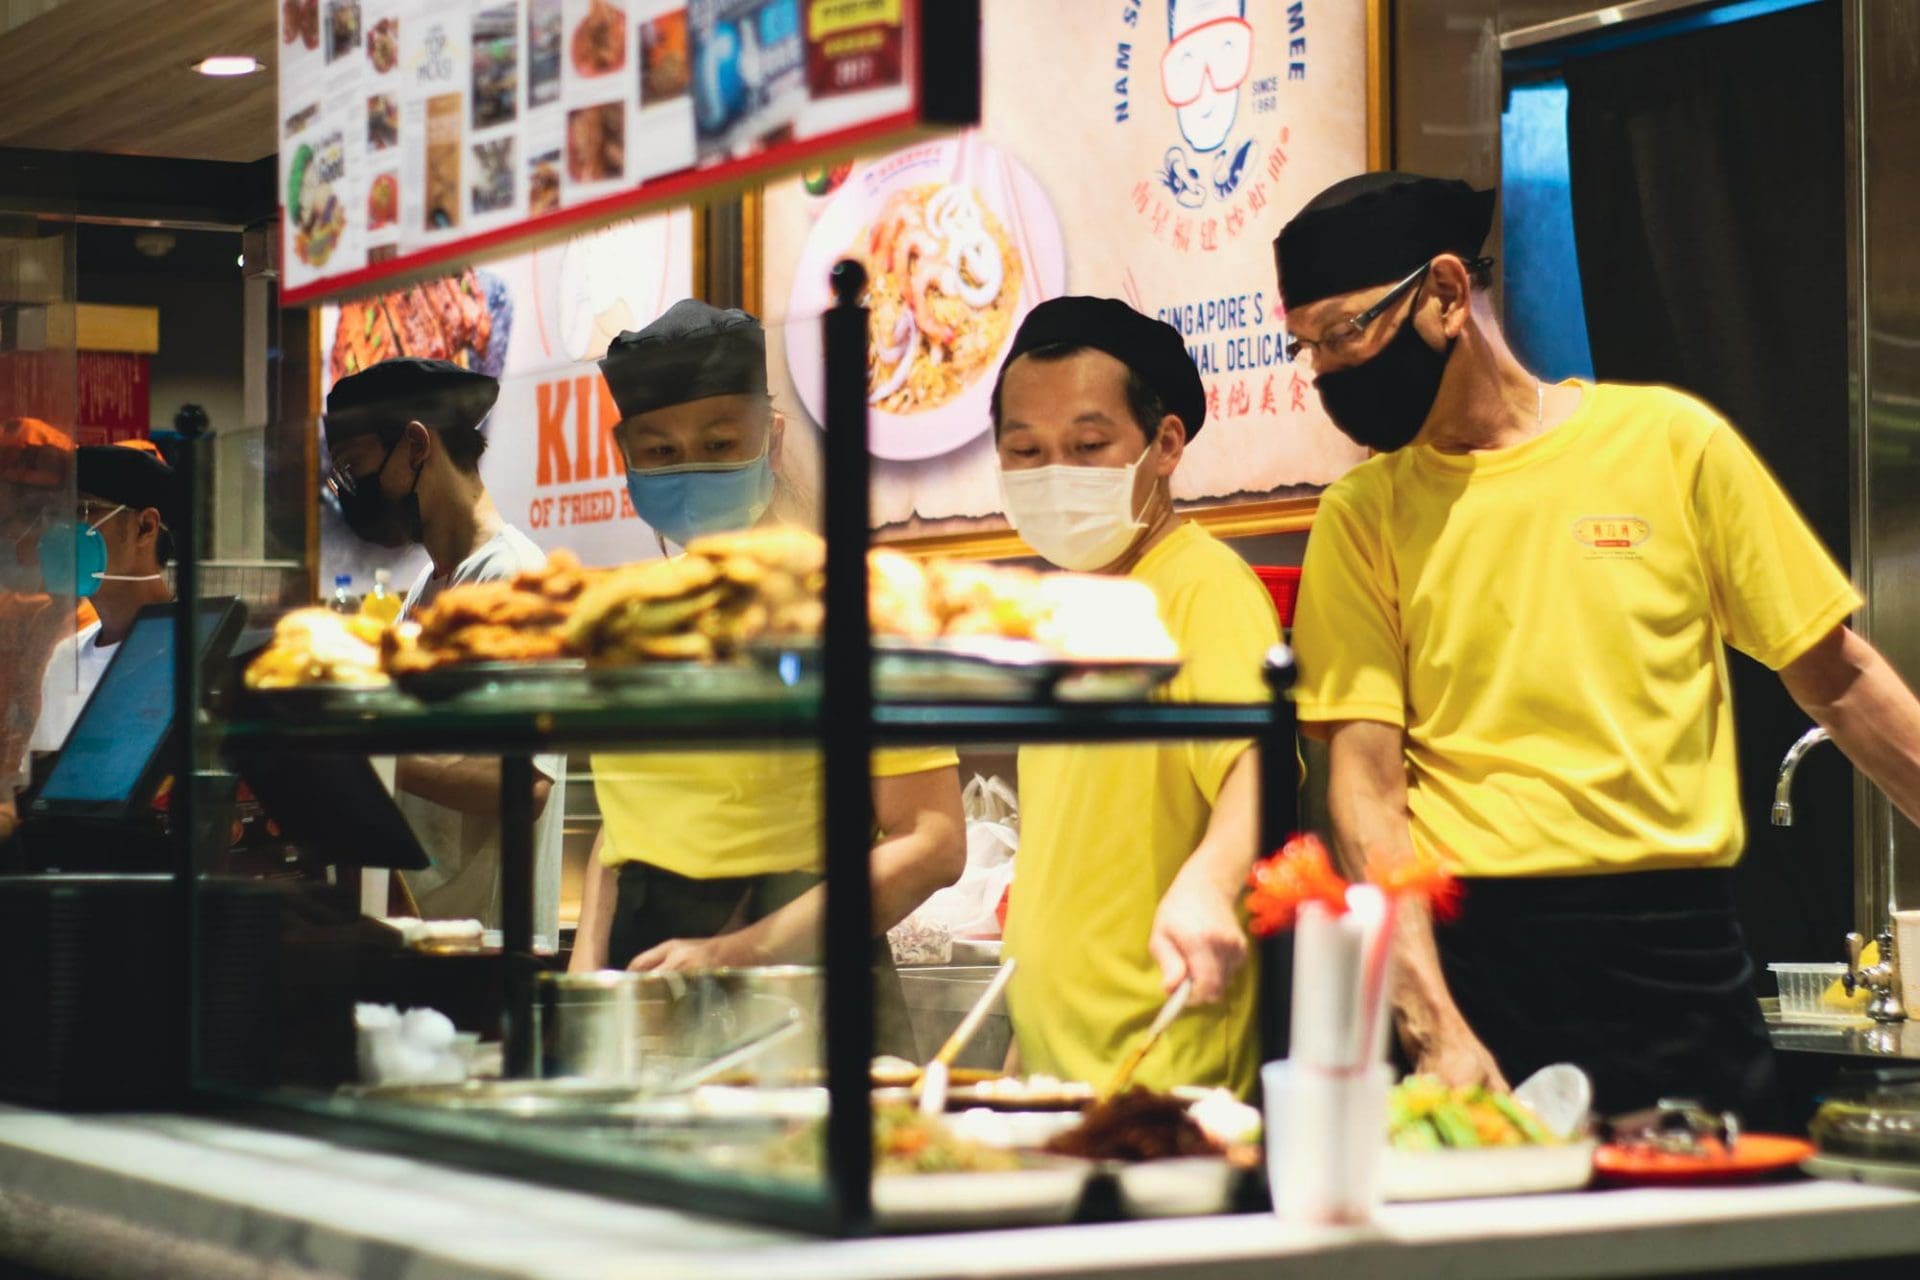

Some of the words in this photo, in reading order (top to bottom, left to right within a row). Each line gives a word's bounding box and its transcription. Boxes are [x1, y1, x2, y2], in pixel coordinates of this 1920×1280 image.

[1286, 1, 1306, 80] MEE
[1227, 332, 1294, 371] DELICA
[536, 373, 627, 487] KIN
[529, 497, 553, 530] OF
[558, 490, 615, 527] FRIED
